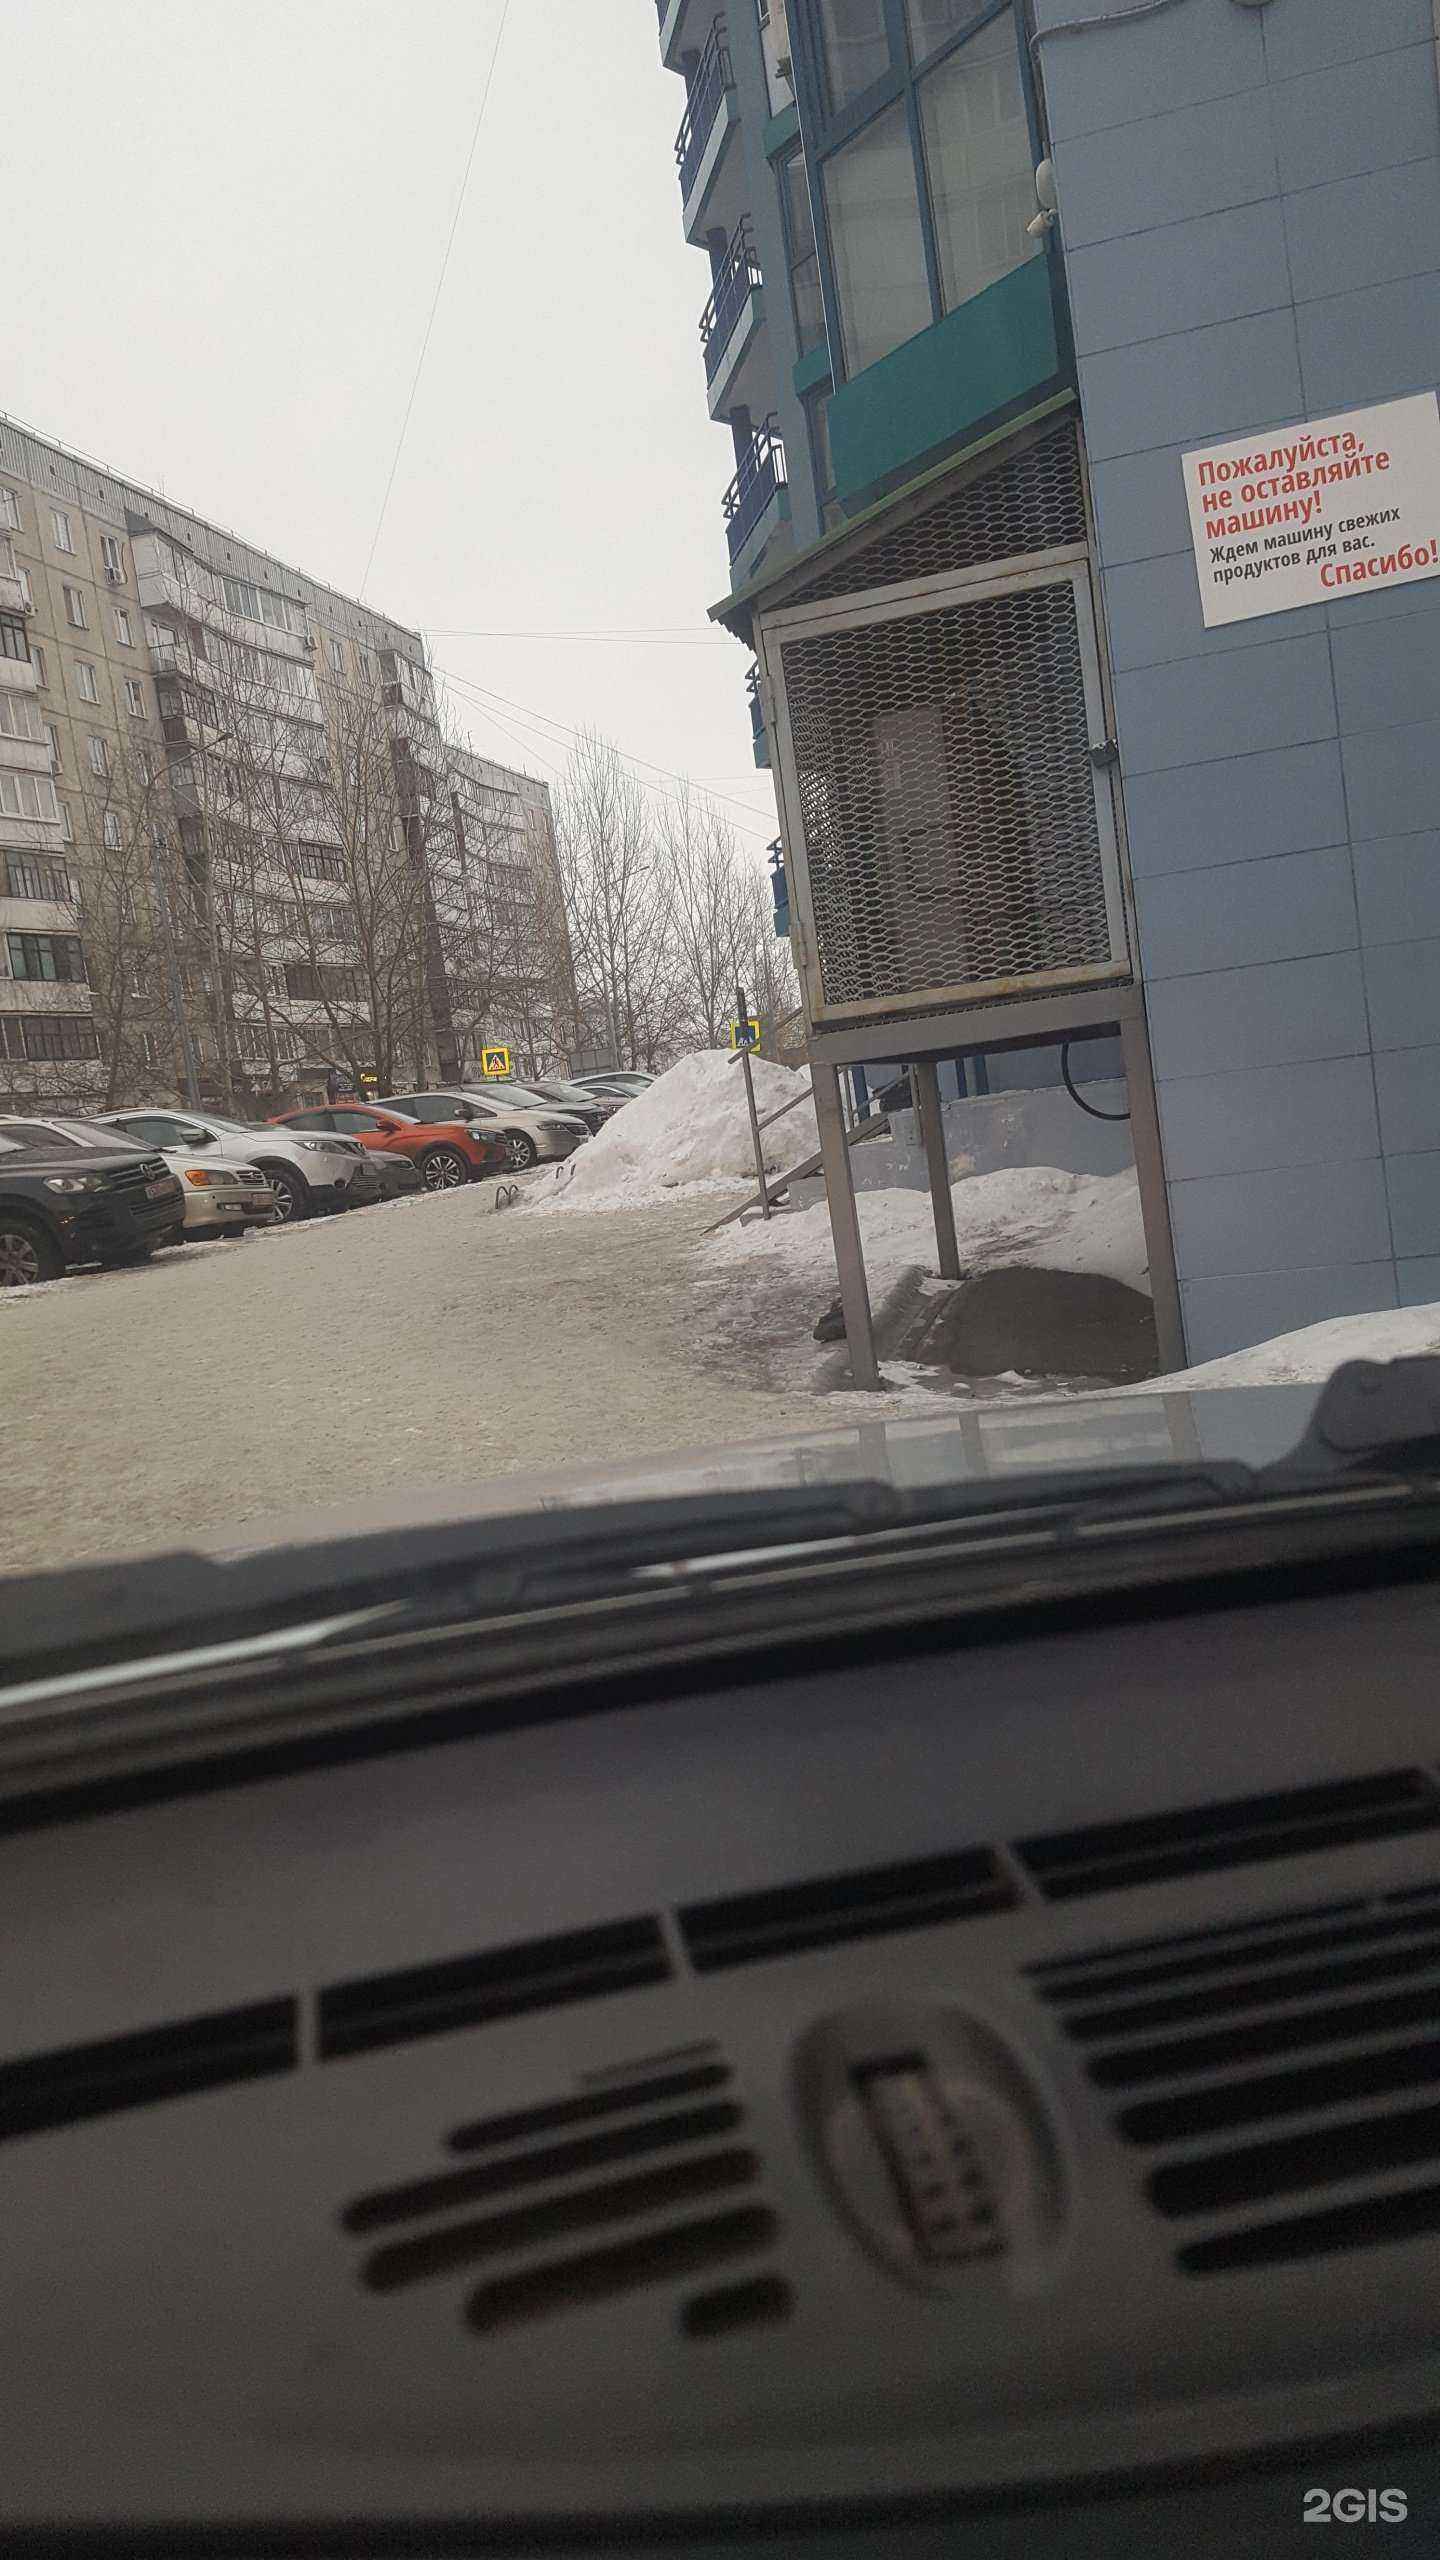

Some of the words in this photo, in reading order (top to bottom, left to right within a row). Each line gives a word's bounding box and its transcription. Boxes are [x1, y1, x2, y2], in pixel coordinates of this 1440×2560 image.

[1198, 431, 1366, 487] Пожалуйста,
[1202, 487, 1233, 513] не
[1240, 451, 1390, 503] оставляйте
[1205, 490, 1323, 539] машину!
[1209, 538, 1259, 565] Ждем
[1264, 521, 1333, 552] машину
[1338, 506, 1401, 534] свежих
[1213, 551, 1301, 585] продуктов
[1305, 543, 1337, 565] для
[1343, 534, 1376, 553] вас.
[1320, 538, 1439, 588] Спасибо!
